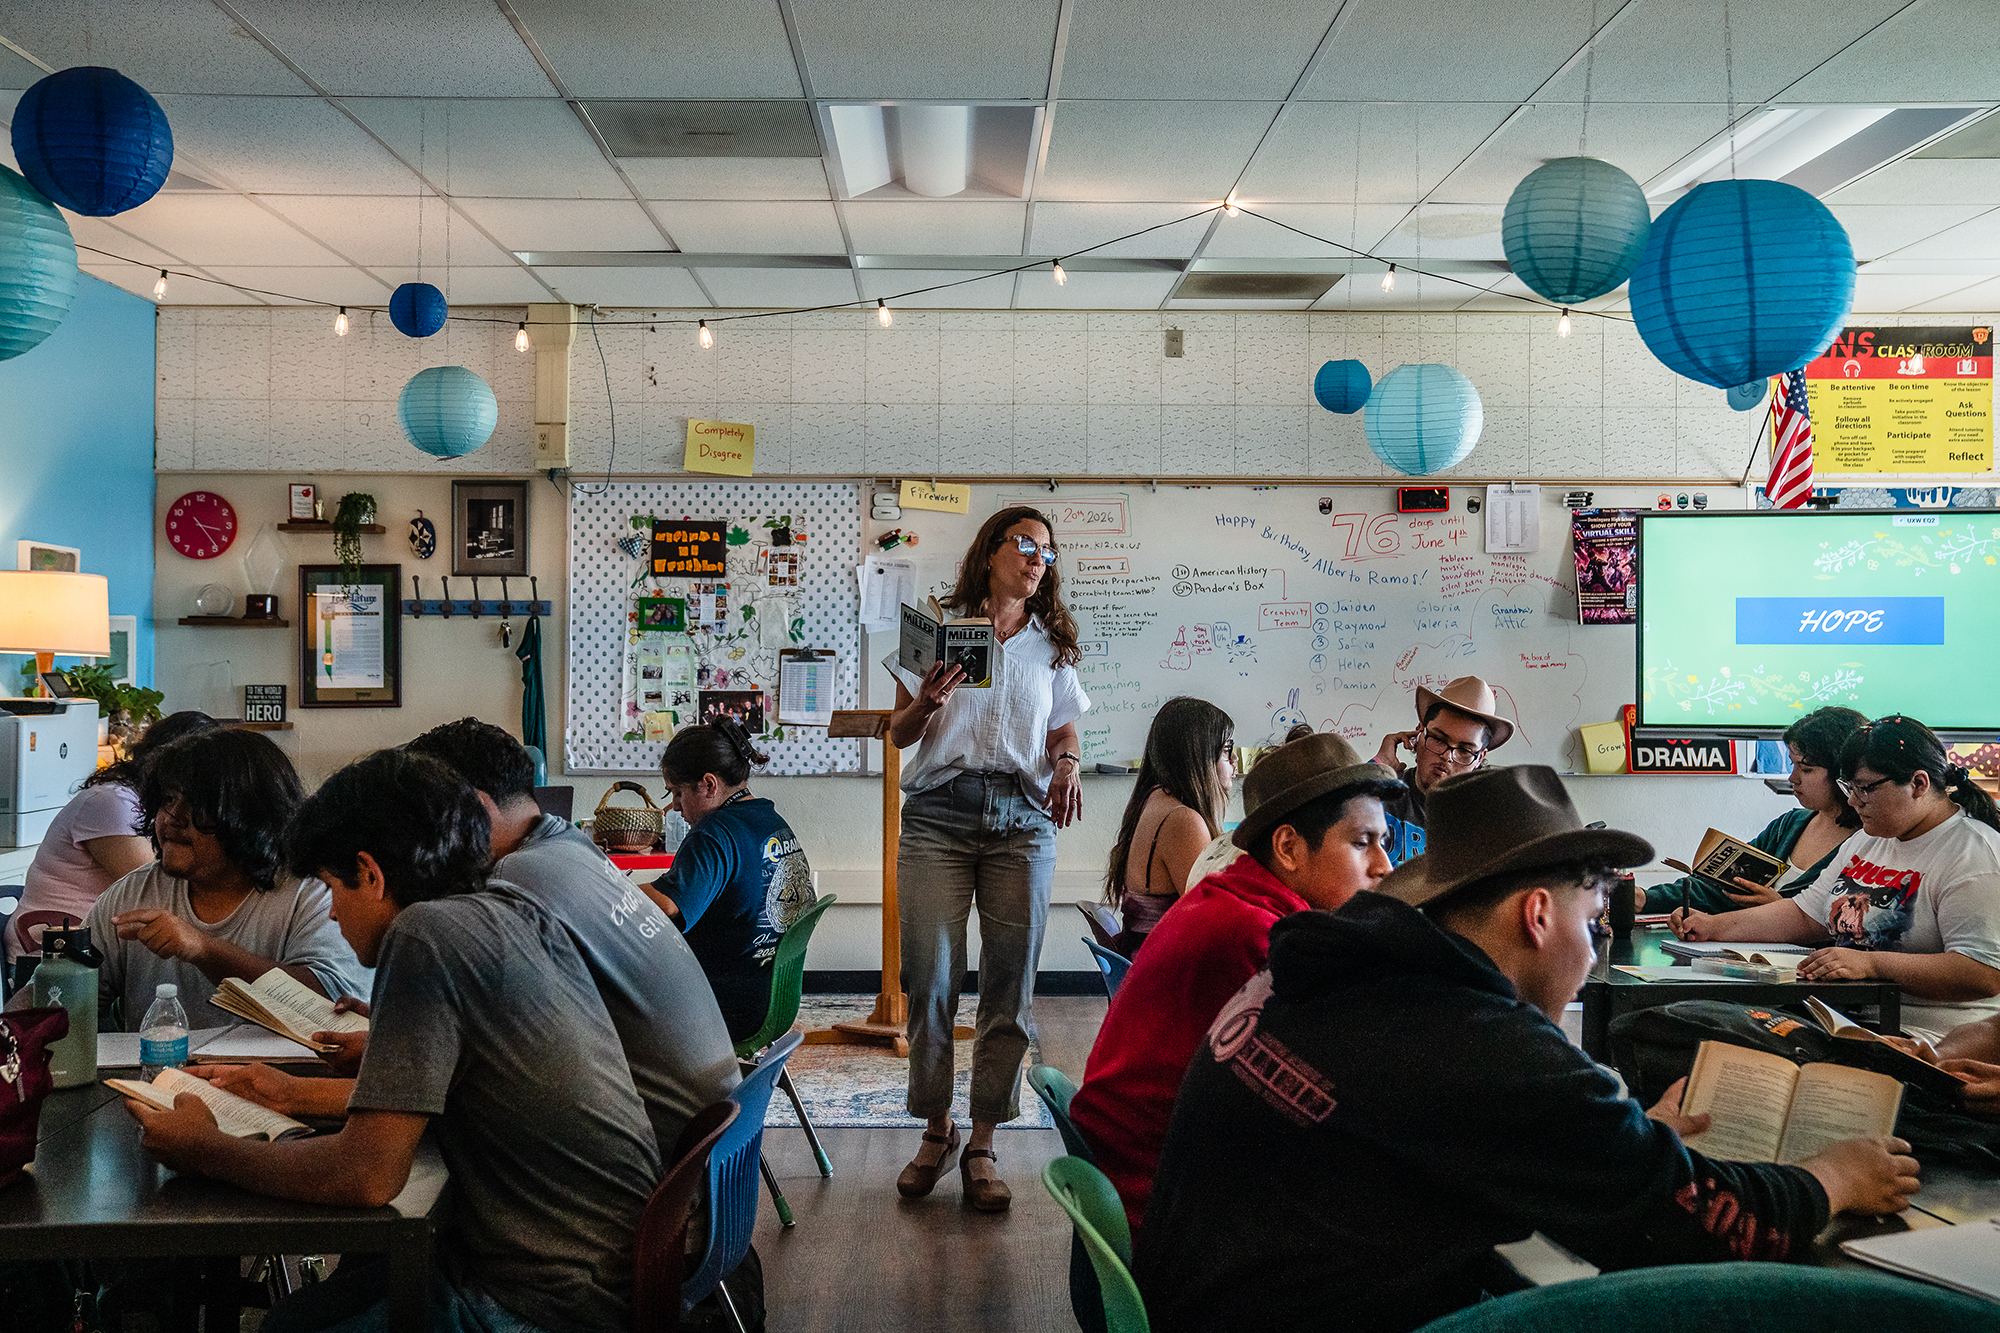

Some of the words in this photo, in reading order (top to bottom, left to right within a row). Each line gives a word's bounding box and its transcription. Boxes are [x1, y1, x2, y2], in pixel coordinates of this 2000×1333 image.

[1877, 343, 1974, 358] CLASROOM
[1945, 410, 1987, 418] Questions
[694, 422, 745, 442] Completely
[1887, 431, 1931, 440] Participate
[699, 444, 742, 461] Disagree
[1949, 452, 1984, 461] Reflect
[910, 486, 959, 504] Fireworks
[1087, 510, 1114, 524] 2026
[1332, 512, 1400, 556] 76
[1408, 518, 1434, 531] days
[1440, 516, 1465, 525] until
[1412, 534, 1446, 550] June
[1448, 529, 1468, 546] 4th
[1582, 529, 1614, 538] VIRTUAL
[1215, 513, 1256, 528] Happy
[1260, 526, 1310, 563] Birthday,
[1312, 558, 1360, 583] Alberto
[1078, 561, 1112, 572] Drama
[1192, 567, 1235, 578] American
[1237, 564, 1268, 578] History
[1440, 564, 1464, 572] music
[1071, 577, 1108, 586] Showcase
[1112, 576, 1160, 587] Preparation
[1441, 572, 1462, 582] sound
[1194, 581, 1240, 594] Pandora's
[1244, 580, 1264, 591] Box
[1440, 582, 1461, 593] silent
[1442, 588, 1481, 599] narration
[1262, 608, 1308, 618] Creativity
[1332, 600, 1376, 614] Jaiden
[1417, 600, 1460, 612] Gloria
[904, 611, 934, 638] MILLER
[1334, 617, 1386, 634] Raymond
[1413, 618, 1458, 632] Valeria
[1494, 616, 1528, 629] Attic
[1798, 609, 1885, 632] HOPE
[948, 630, 988, 640] MILLER
[1095, 643, 1101, 651] 9
[1531, 653, 1543, 661] box
[1078, 663, 1096, 673] ield
[1100, 662, 1121, 678] Trip
[1338, 658, 1371, 672] Helen
[1080, 680, 1141, 696] Imagining
[1402, 674, 1434, 689] SMILE
[254, 686, 263, 694] THE
[1141, 695, 1159, 709] and
[246, 704, 282, 721] HERO
[1090, 737, 1108, 751] panel
[1636, 747, 1726, 767] DRAMA
[1702, 846, 1737, 875] MILLER
